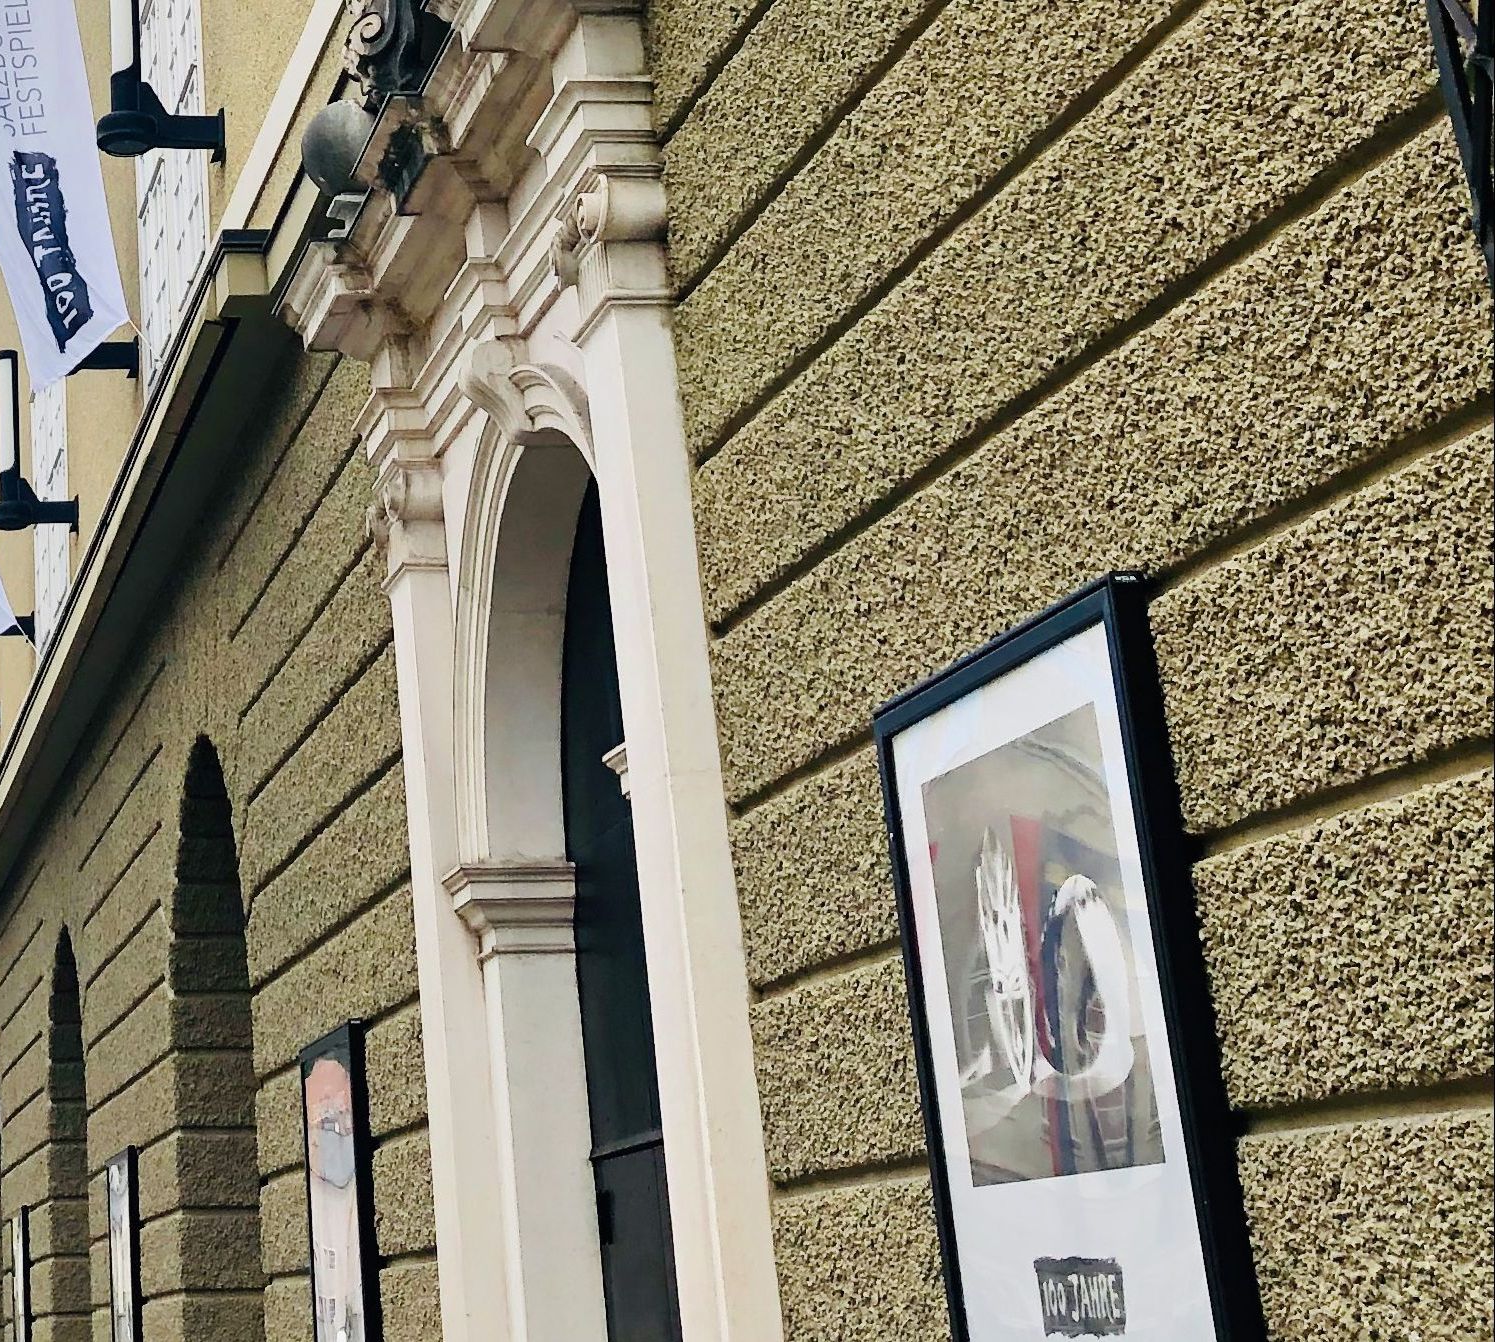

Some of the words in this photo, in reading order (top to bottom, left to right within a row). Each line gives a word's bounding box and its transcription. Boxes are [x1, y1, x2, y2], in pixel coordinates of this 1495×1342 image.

[45, 272, 78, 329] 100
[1042, 1278, 1066, 1317] 100
[1067, 1273, 1121, 1324] JAHRE
